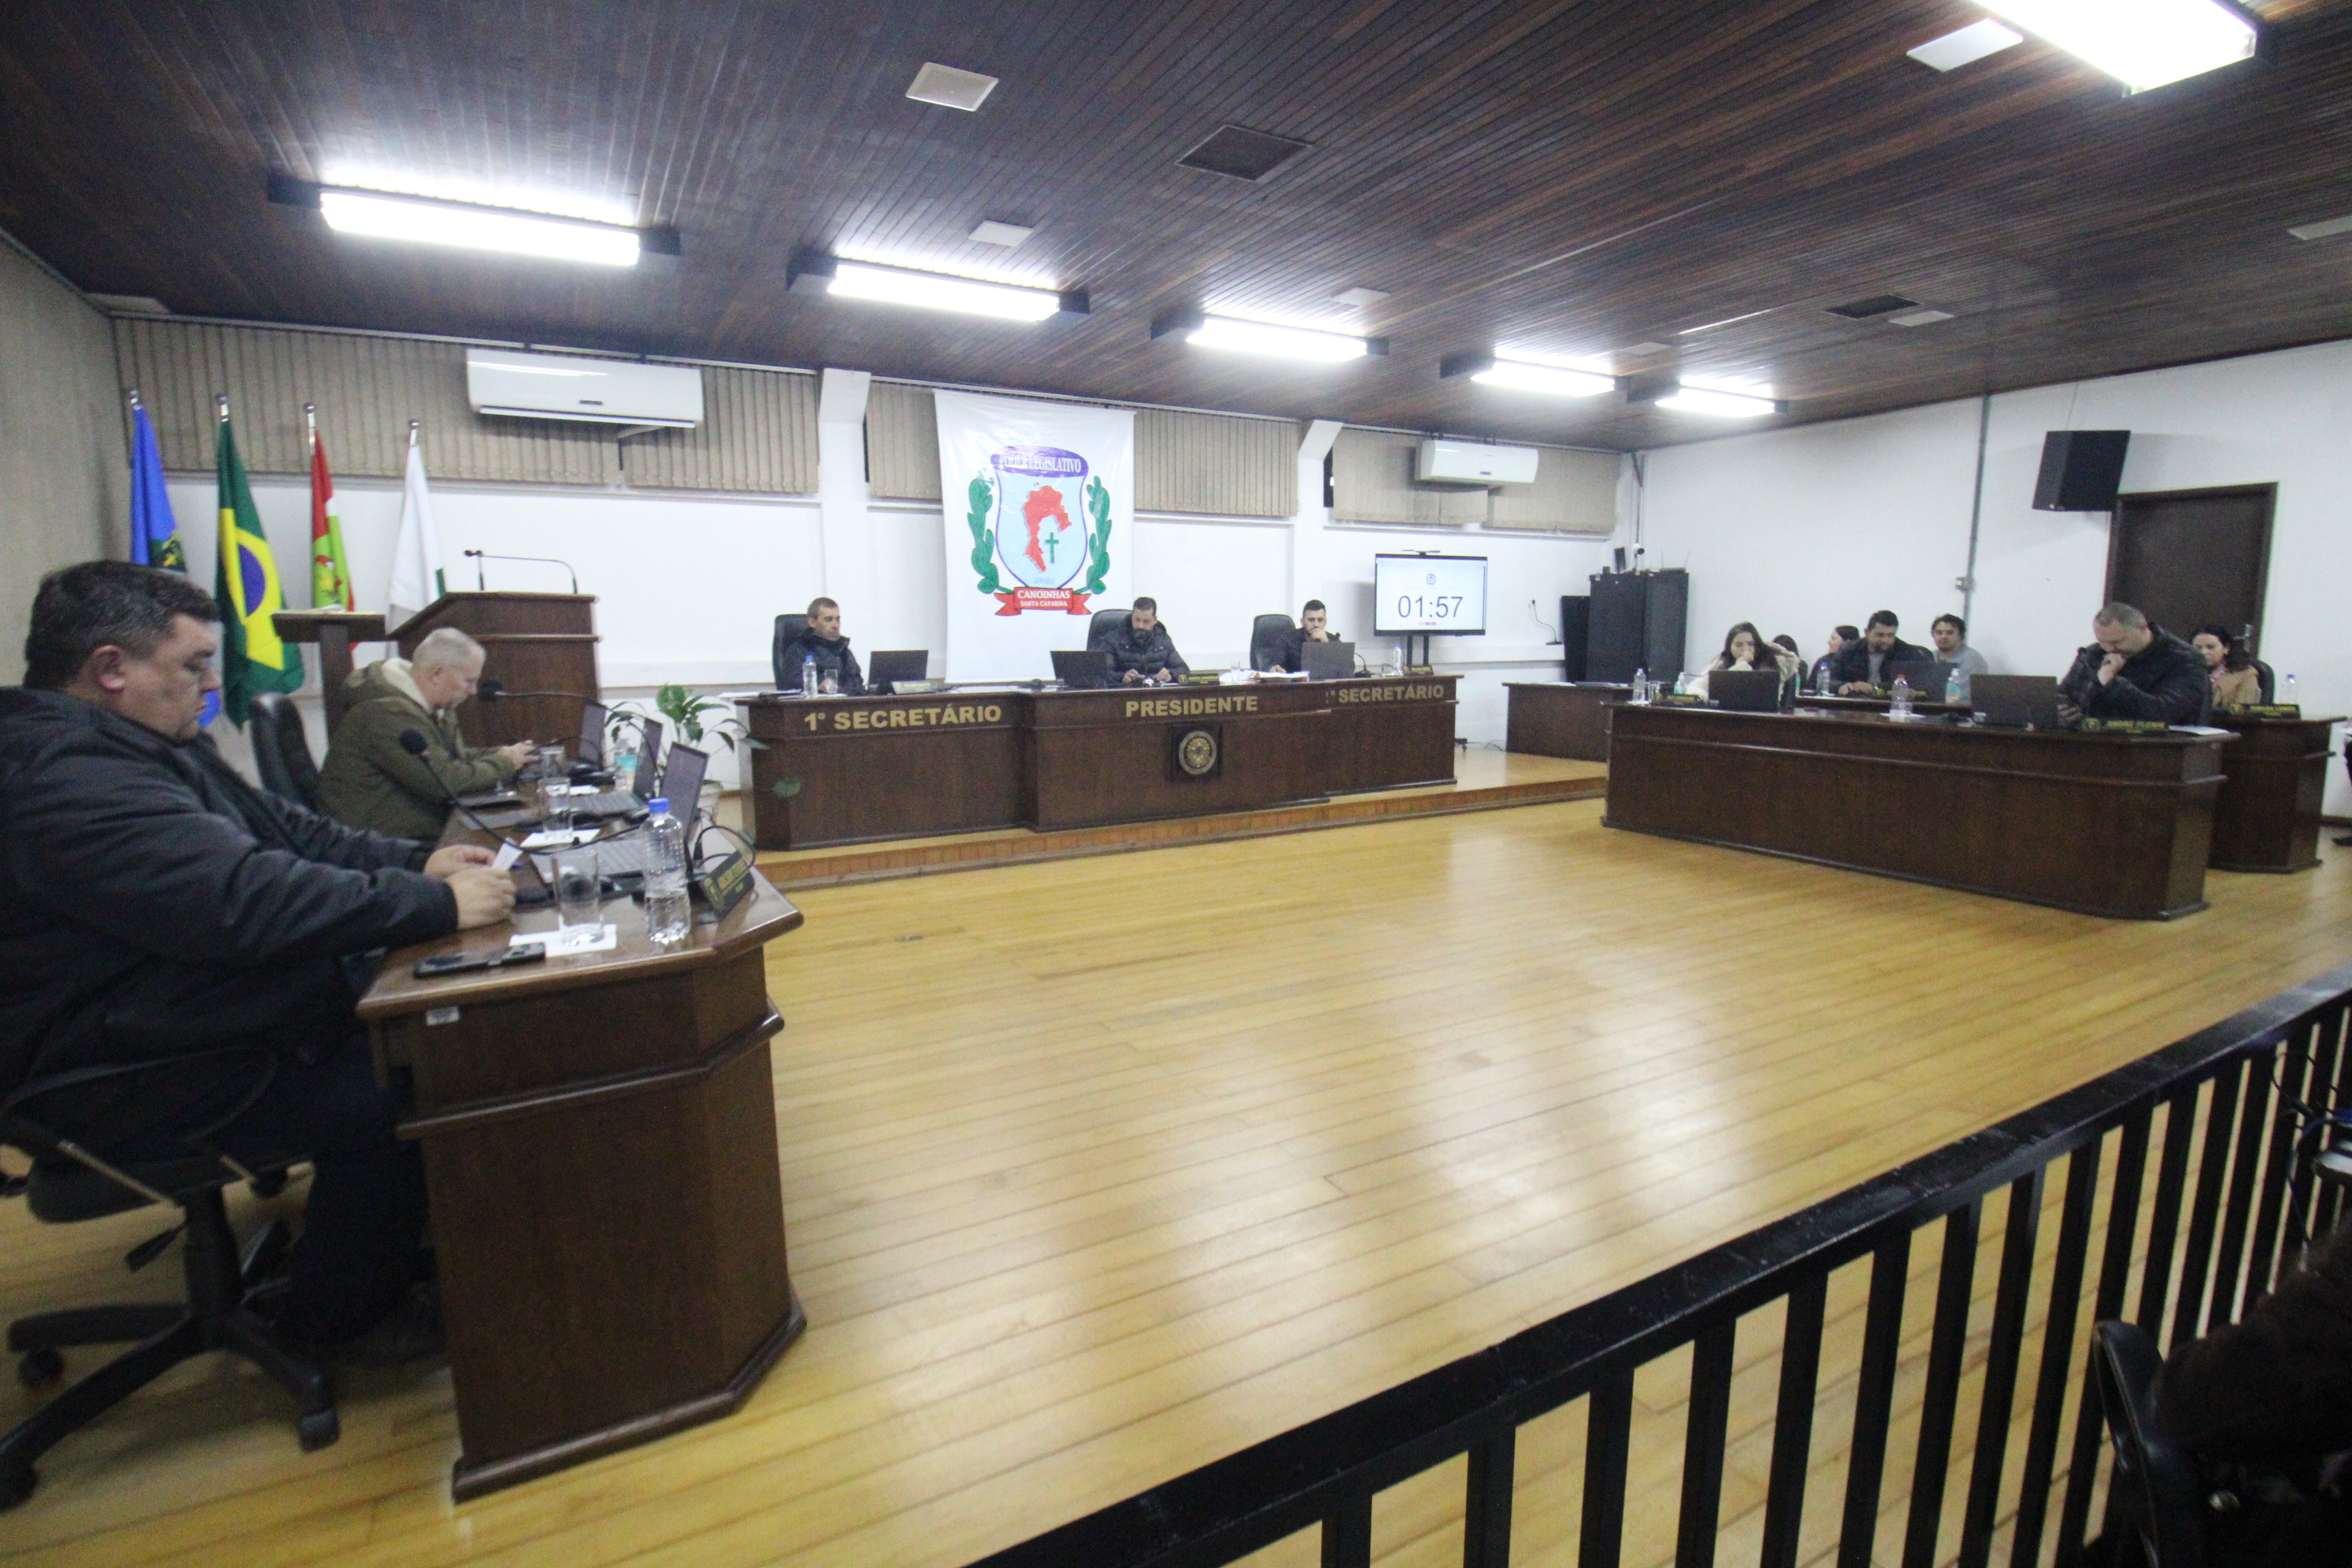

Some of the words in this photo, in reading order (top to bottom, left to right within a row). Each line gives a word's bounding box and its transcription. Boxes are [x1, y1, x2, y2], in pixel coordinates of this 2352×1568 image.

[1029, 456, 1082, 473] LEGISLATIVO
[1017, 590, 1071, 599] CANOINHAS
[1398, 595, 1463, 618] 01:57
[1338, 684, 1445, 703] SECRETÁRIO
[834, 703, 1001, 730] SECRETÁRIO
[1125, 695, 1258, 718] PRESIDENTE
